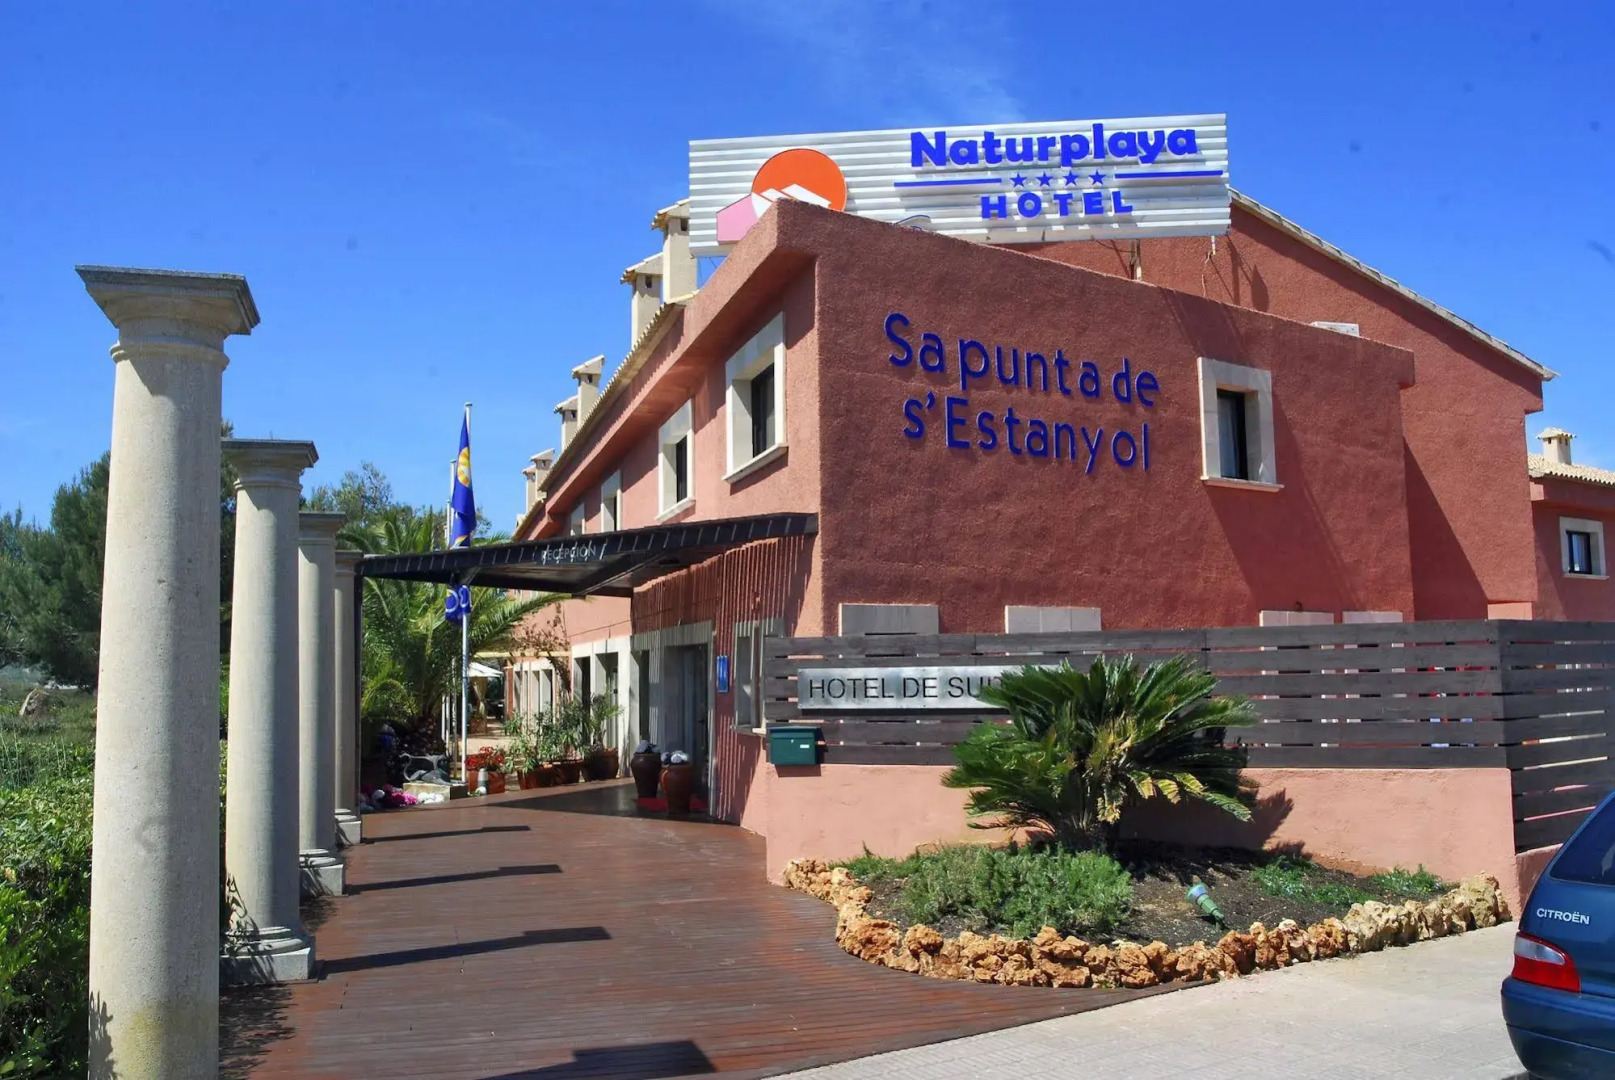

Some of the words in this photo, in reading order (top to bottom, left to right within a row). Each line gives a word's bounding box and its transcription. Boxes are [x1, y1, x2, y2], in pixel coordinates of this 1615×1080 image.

[910, 122, 1198, 168] Naturplaya
[980, 190, 1133, 219] HOTEL
[884, 312, 945, 374] Sa
[957, 338, 1101, 399] punta
[1112, 357, 1160, 407] de
[808, 677, 895, 699] HOTEL
[902, 677, 939, 699] DE
[1536, 907, 1590, 925] CITROËN
